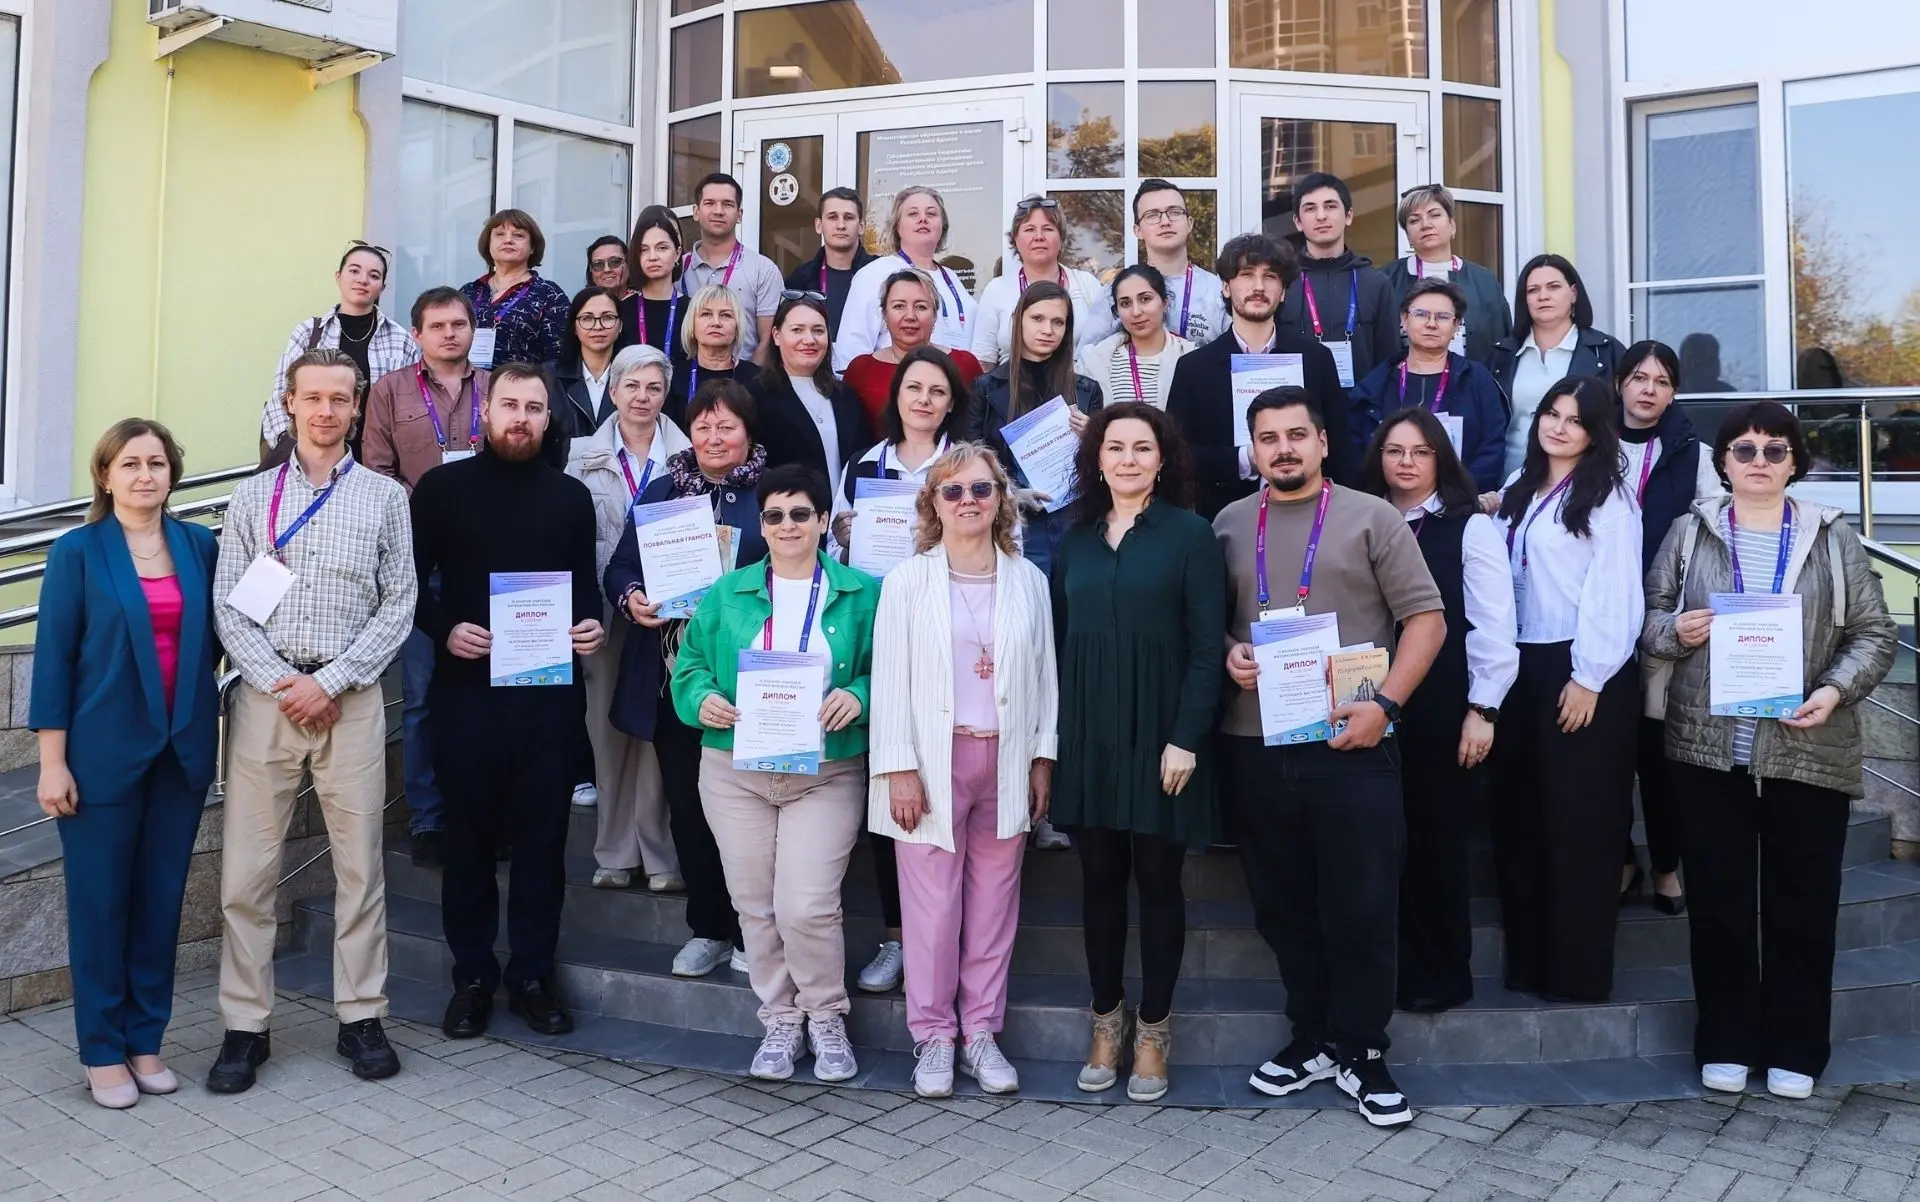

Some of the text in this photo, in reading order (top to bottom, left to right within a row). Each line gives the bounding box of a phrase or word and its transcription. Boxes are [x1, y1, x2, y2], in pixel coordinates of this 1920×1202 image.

[1020, 438, 1054, 461] ПОХВАЛЬНАЯ
[876, 516, 907, 524] ДИПЛОМ
[643, 532, 713, 549] ПОХВАЛЬНАЯ ГРАМОТА
[515, 611, 548, 619] ДИПЛОМ
[1738, 635, 1775, 643] ДИПЛОМ
[1284, 660, 1317, 670] ДИПЛОМ
[762, 692, 796, 701] ДИПЛОМ
